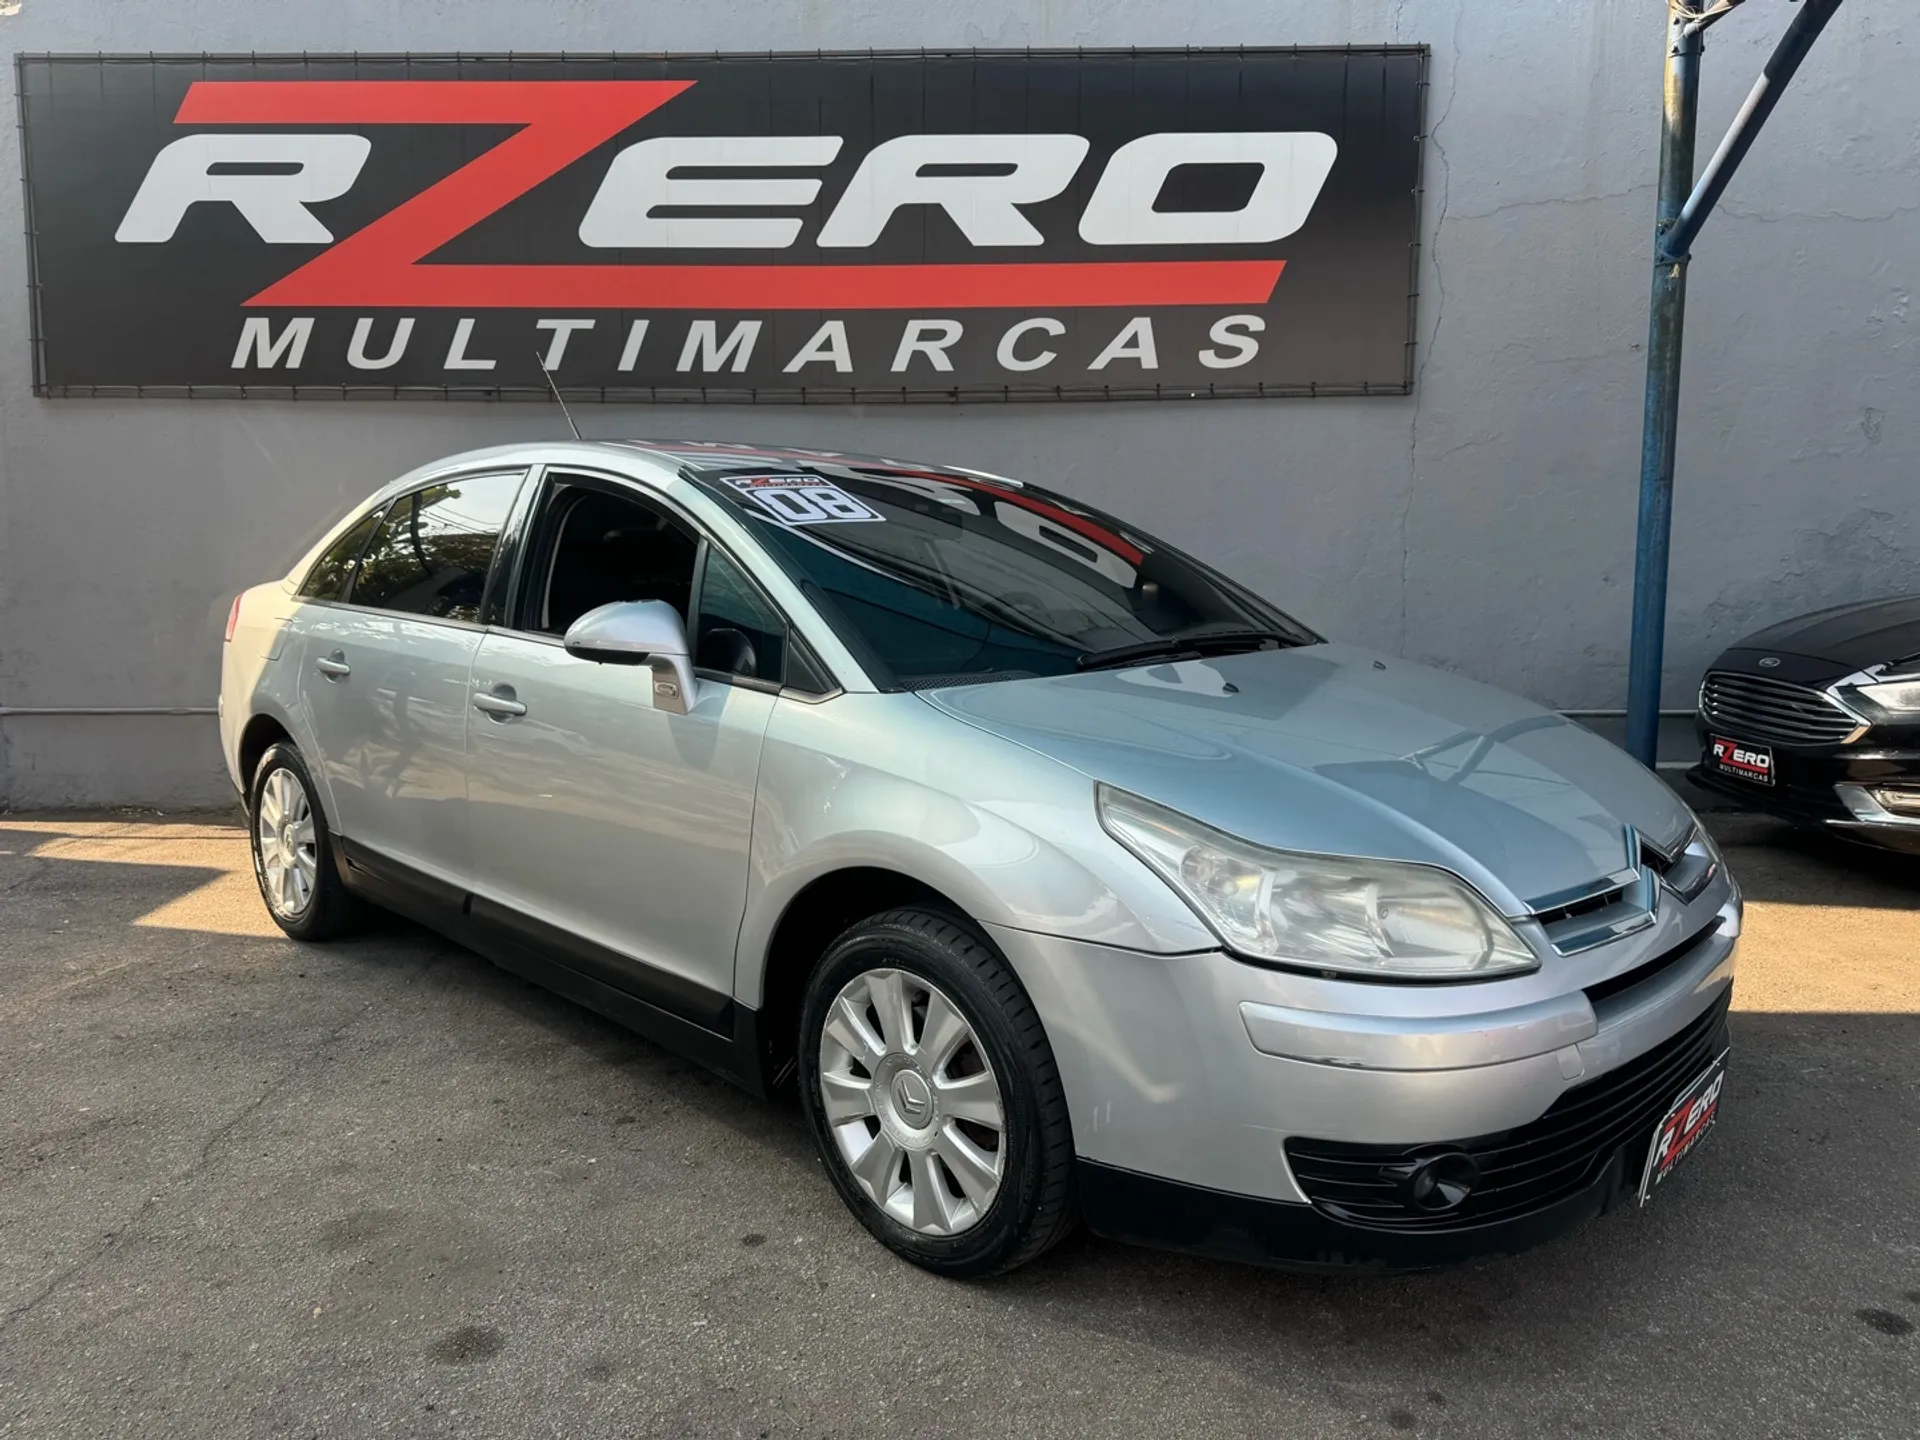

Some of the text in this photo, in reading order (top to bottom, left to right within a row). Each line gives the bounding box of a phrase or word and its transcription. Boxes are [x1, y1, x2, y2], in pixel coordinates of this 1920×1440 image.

[115, 80, 1338, 308] RZERO
[231, 314, 1266, 373] MULTIMARCAS
[754, 488, 872, 520] 08
[1713, 738, 1770, 772] RZERO
[1652, 1069, 1725, 1171] RZERO
